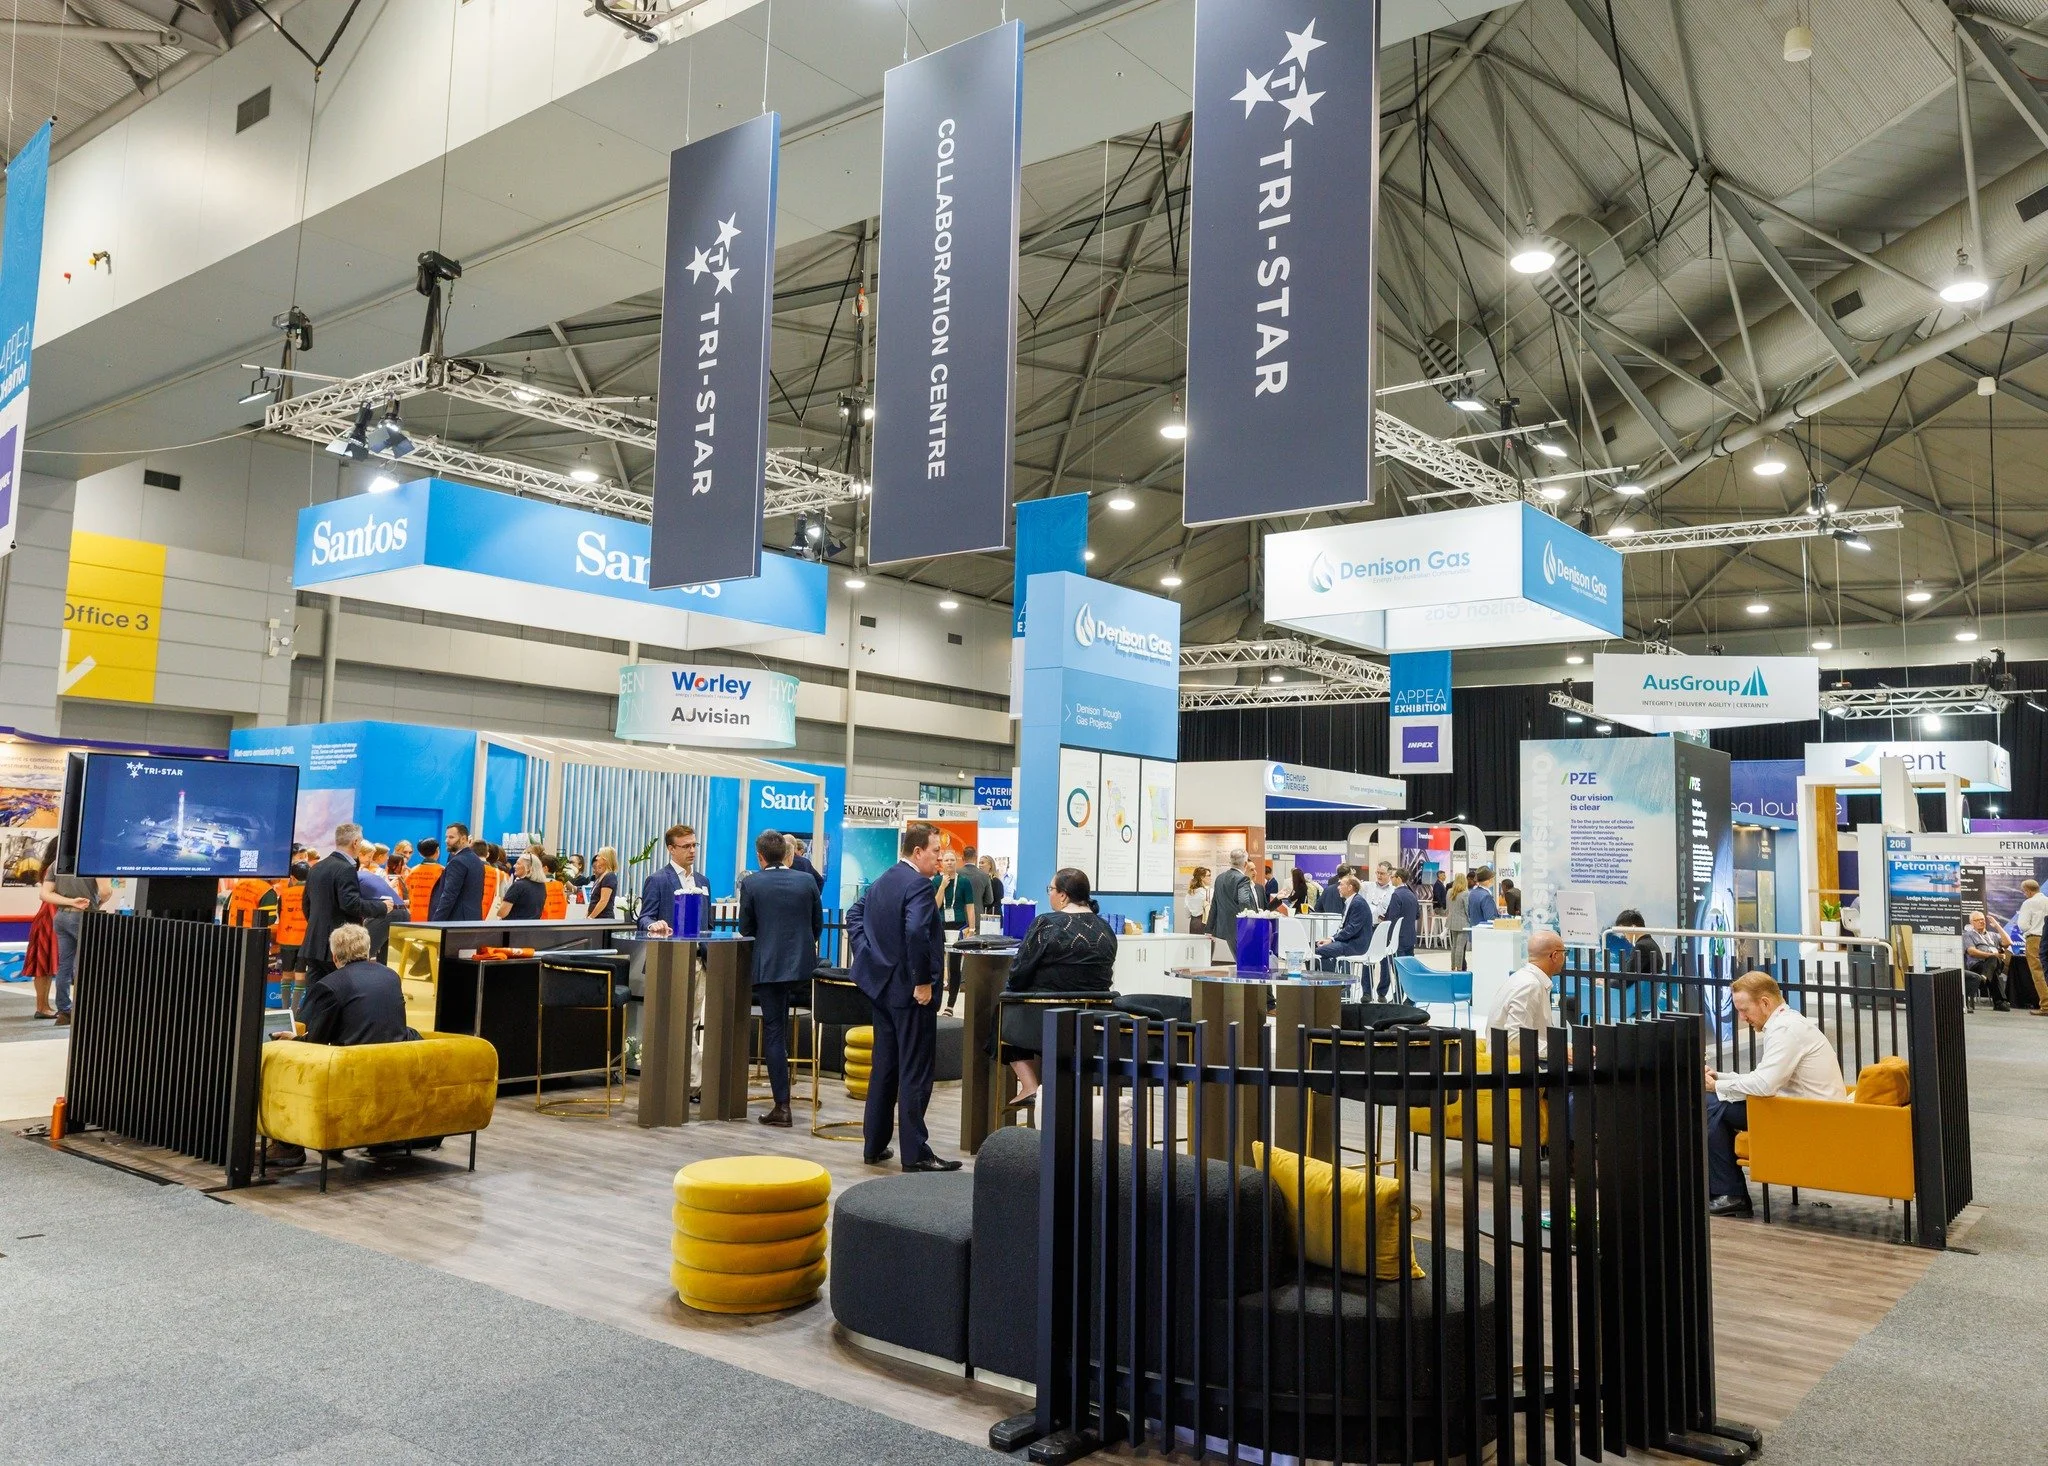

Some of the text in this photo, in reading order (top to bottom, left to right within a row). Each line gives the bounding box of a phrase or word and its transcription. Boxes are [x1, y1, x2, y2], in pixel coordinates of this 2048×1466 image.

[1255, 137, 1293, 398] TRI-STAR
[927, 118, 956, 480] COLLABORATION CENTRE
[692, 302, 720, 496] TRI-STAR
[311, 513, 408, 567] Santos
[1340, 550, 1471, 580] Denison Gas
[1557, 558, 1590, 590] Denison
[1592, 575, 1608, 598] Gas
[135, 614, 149, 631] 3
[1097, 620, 1146, 650] Denison
[1149, 633, 1173, 655] Gas
[671, 671, 752, 701] Worley
[1642, 674, 1741, 696] AusGroup
[1395, 688, 1446, 705] APPEA
[1076, 703, 1122, 722] Denison Trough
[1394, 703, 1447, 713] EXHIBITION
[1076, 716, 1113, 730] Gas Projects
[1883, 751, 1946, 770] ent
[144, 767, 183, 776] TRI-STAR
[1570, 794, 1613, 802] Our vision
[857, 805, 899, 818] PAVILION
[1889, 839, 1907, 849] 206
[1894, 861, 1951, 871] Petromac
